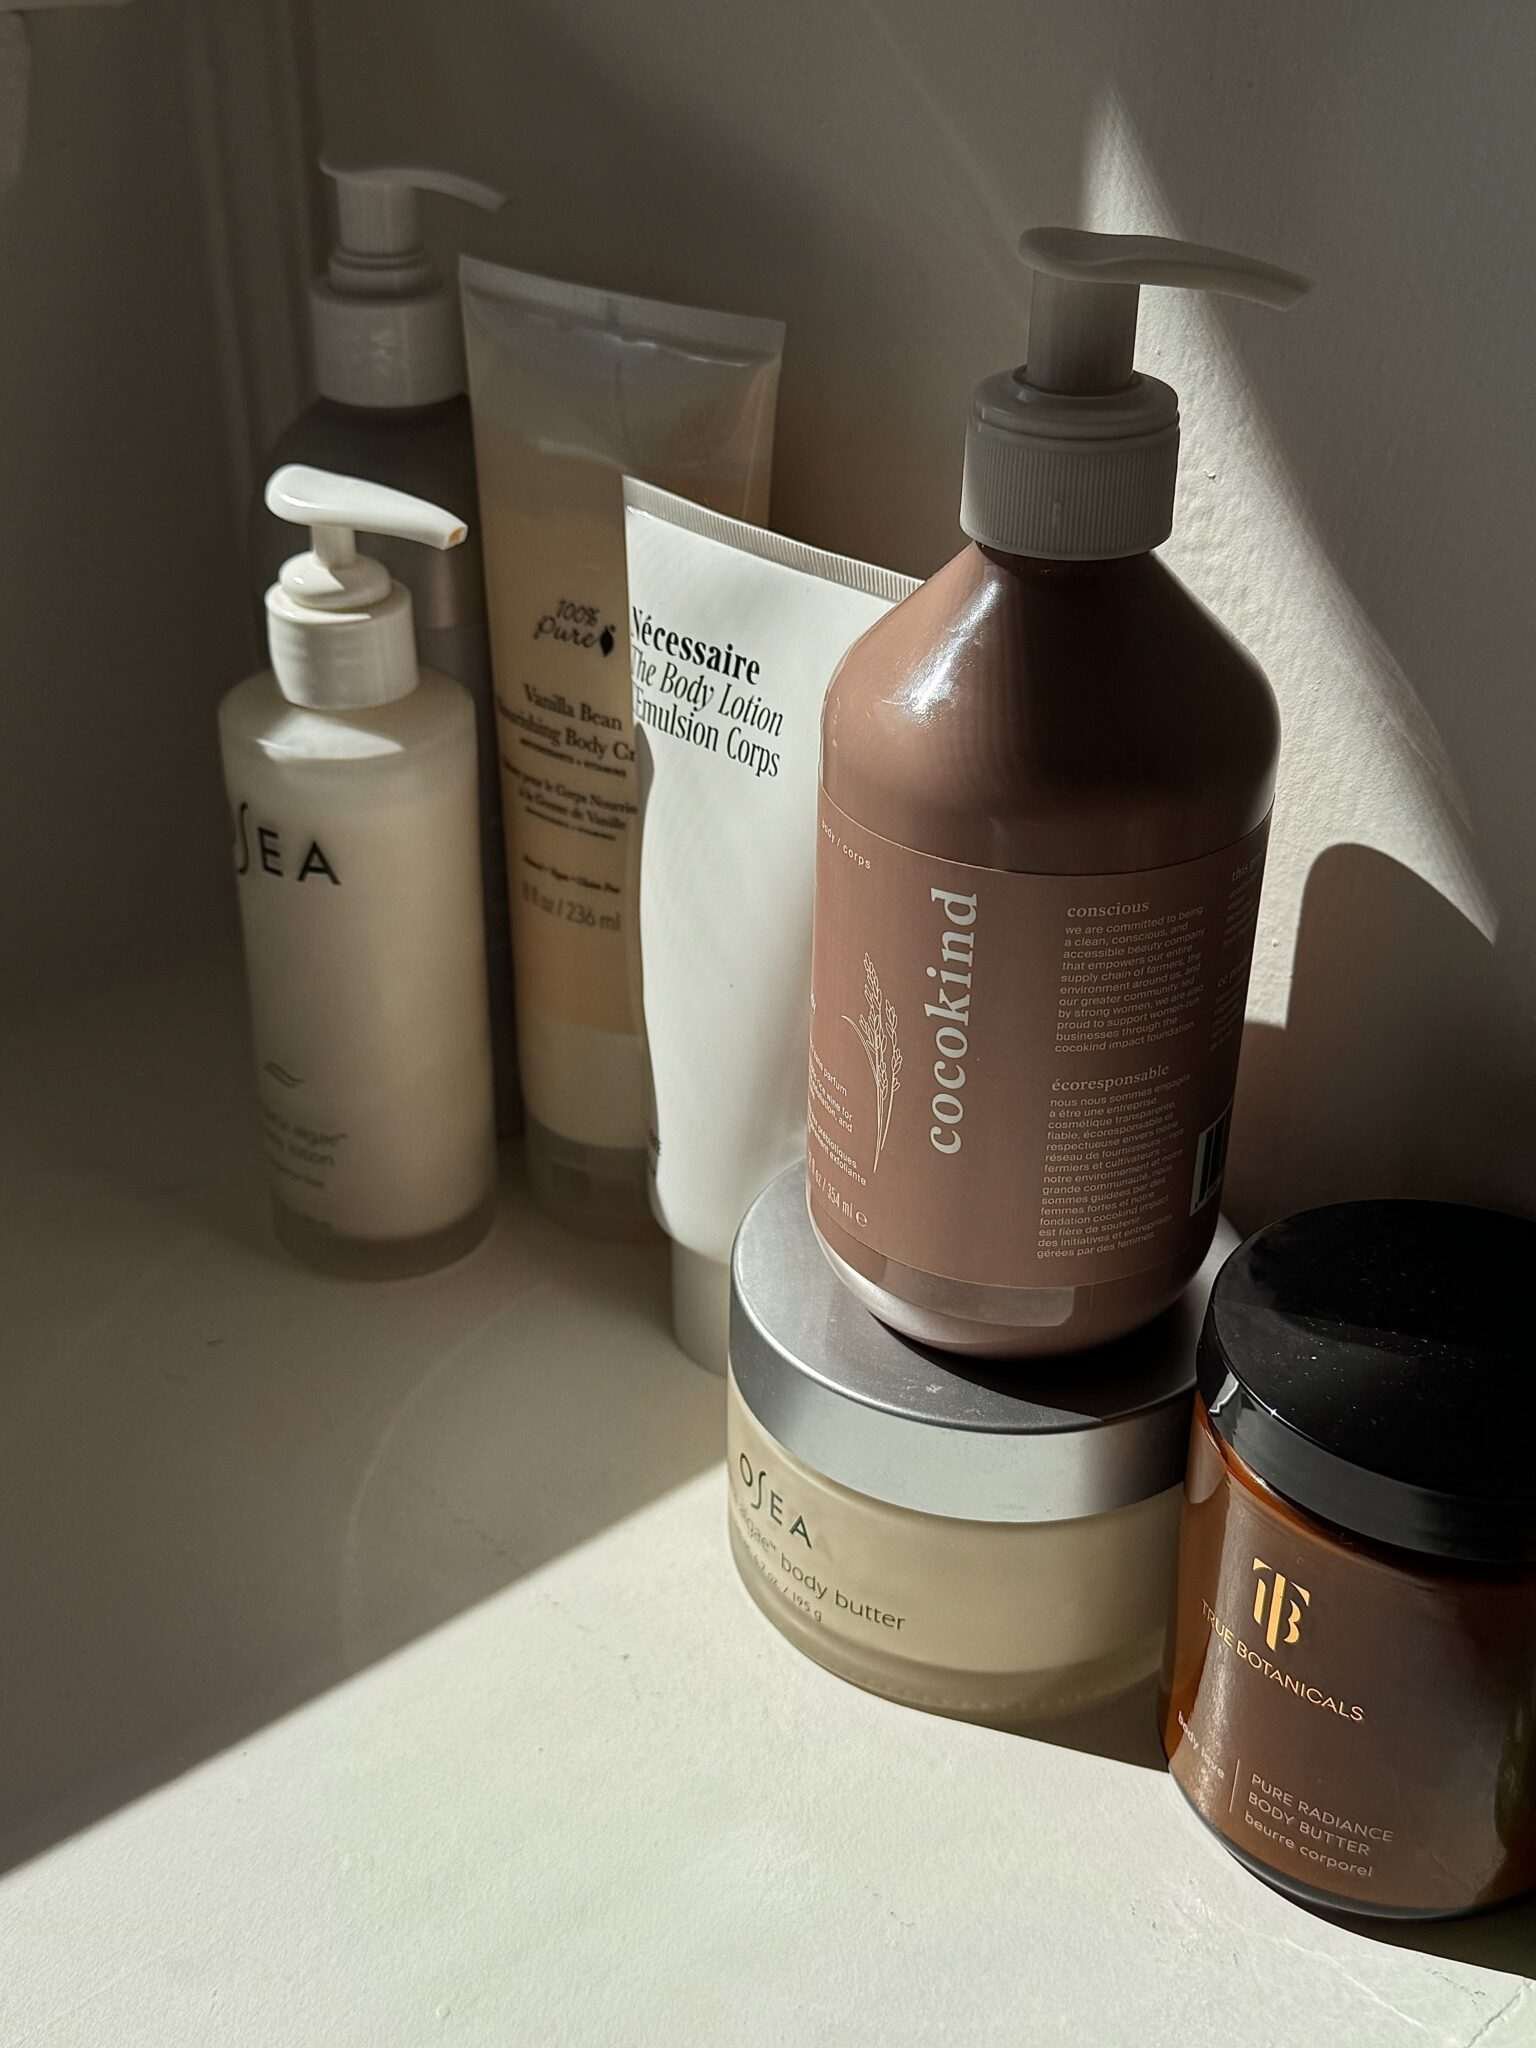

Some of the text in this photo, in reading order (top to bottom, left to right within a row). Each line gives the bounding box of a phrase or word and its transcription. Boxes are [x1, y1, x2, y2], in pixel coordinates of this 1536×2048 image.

[556, 599, 600, 627] 100%
[532, 614, 597, 649] Pure
[523, 683, 576, 719] Vanilla
[580, 702, 623, 731] Bean
[659, 661, 715, 712] Body
[717, 682, 784, 737] Lotion
[633, 684, 719, 753] Emulsion
[726, 725, 781, 778] Corps
[565, 727, 609, 760] Body
[238, 802, 342, 886] SEA
[842, 843, 872, 870] corps
[566, 900, 596, 927] 236
[599, 910, 621, 931] ml
[1067, 902, 1150, 918] conscious
[1106, 917, 1164, 933] committed
[1064, 939, 1071, 947] a
[1074, 936, 1109, 947] clean,
[1062, 961, 1085, 970] that
[1087, 956, 1145, 971] empowers
[1147, 952, 1164, 963] our
[1063, 947, 1125, 959] accessible
[1060, 982, 1130, 994] environment
[1132, 975, 1167, 988] around
[1061, 974, 1098, 983] supply
[1101, 970, 1131, 981] chain
[1059, 997, 1078, 1006] our
[1081, 994, 1121, 1007] greater
[924, 887, 978, 1154] cocokind
[1057, 1021, 1090, 1030] proud
[1093, 1018, 1104, 1028] to
[1107, 1013, 1148, 1026] support
[1058, 1009, 1071, 1018] by
[1074, 1007, 1110, 1017] strong
[1055, 1041, 1106, 1052] cocokind
[1109, 1036, 1145, 1048] impact
[1056, 1030, 1119, 1041] businesses
[823, 1067, 848, 1097] parfum
[1052, 1064, 1169, 1092] écoresponsable
[1050, 1099, 1078, 1107] nous
[1081, 1096, 1106, 1106] nous
[1084, 1107, 1104, 1116] une
[838, 1116, 853, 1134] and
[1085, 1151, 1100, 1160] de
[1044, 1164, 1090, 1173] fermiers
[1043, 1175, 1073, 1184] notre
[1042, 1185, 1081, 1196] grande
[842, 1200, 853, 1218] ml
[1041, 1196, 1088, 1205] sommes
[1040, 1206, 1084, 1216] femmes
[1040, 1216, 1091, 1226] fondation
[1037, 1239, 1058, 1247] des
[1060, 1233, 1110, 1246] initiatives
[1039, 1228, 1055, 1237] est
[1085, 1225, 1099, 1234] de
[1077, 1248, 1093, 1256] par
[739, 1452, 813, 1550] OSEA
[781, 1552, 907, 1631] body butter
[1200, 1598, 1365, 1722] TRUE BOTANICALS
[1177, 1710, 1199, 1751] body
[1251, 1773, 1395, 1843] PURE RADIANCE
[1248, 1791, 1371, 1857] BODY BUTTER
[1244, 1809, 1374, 1878] beurre corporel
